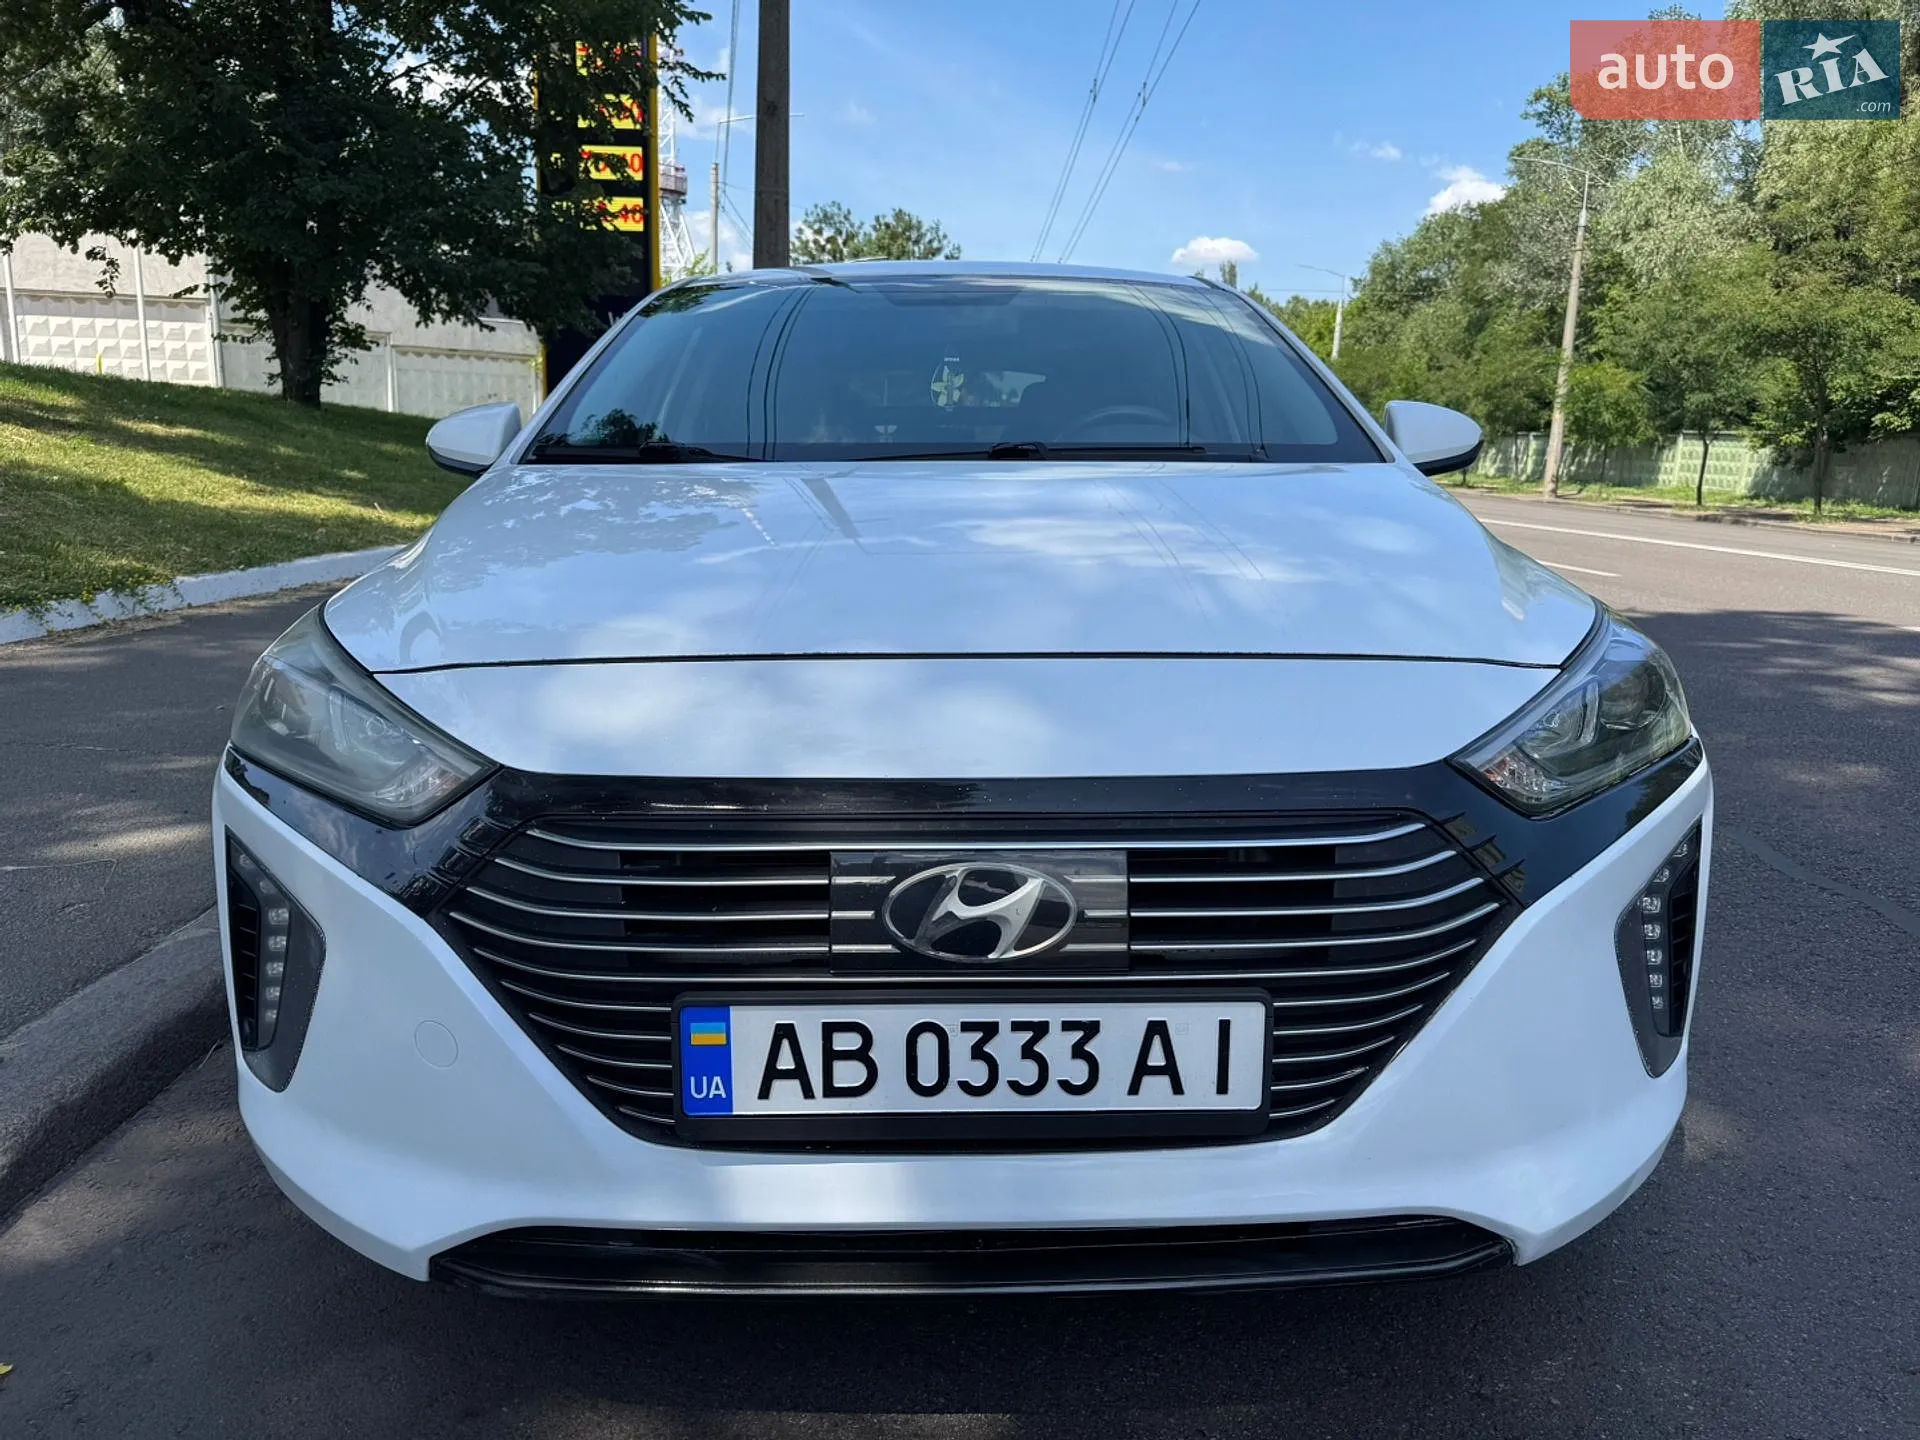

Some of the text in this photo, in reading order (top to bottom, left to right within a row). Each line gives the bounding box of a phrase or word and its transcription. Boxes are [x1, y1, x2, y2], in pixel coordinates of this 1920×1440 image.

[757, 1020, 879, 1100] AB
[905, 1019, 1101, 1097] 0333
[690, 1075, 727, 1099] UA
